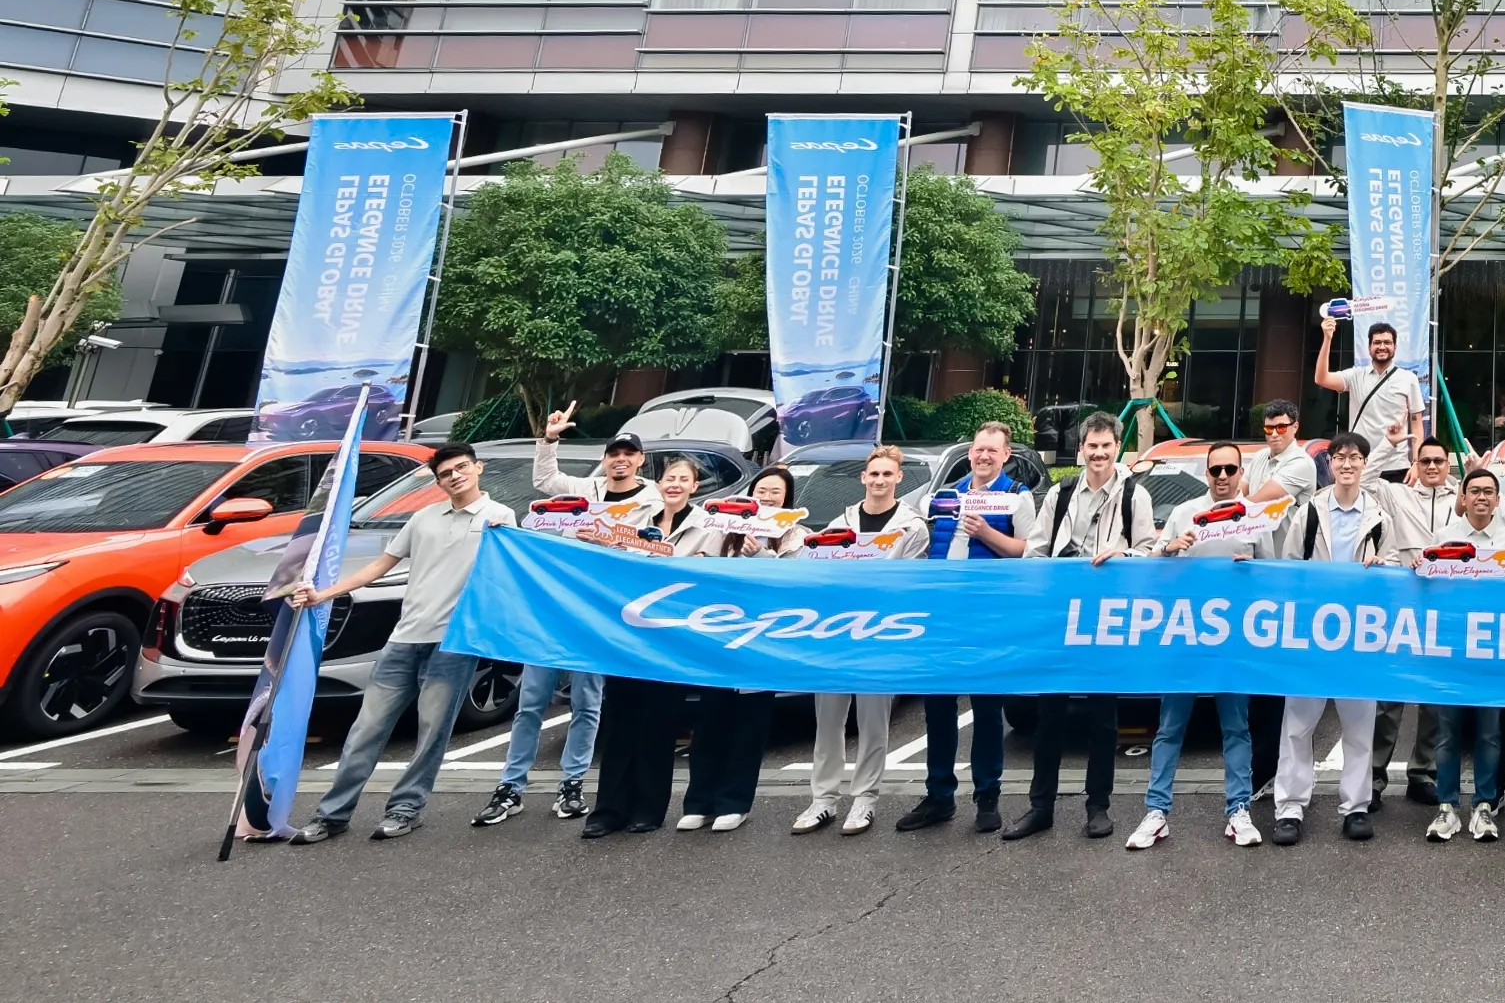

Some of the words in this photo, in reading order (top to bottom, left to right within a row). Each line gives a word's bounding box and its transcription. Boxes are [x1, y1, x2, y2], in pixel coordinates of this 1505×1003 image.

[616, 526, 635, 536] LEPAS
[1199, 528, 1221, 542] Drive
[615, 535, 643, 547] ELEGANT
[643, 542, 672, 554] PARTNER
[1427, 564, 1448, 576] Drive
[621, 582, 931, 649] Lepas
[1064, 597, 1231, 646] LEPAS
[1243, 600, 1452, 657] GLOBAL
